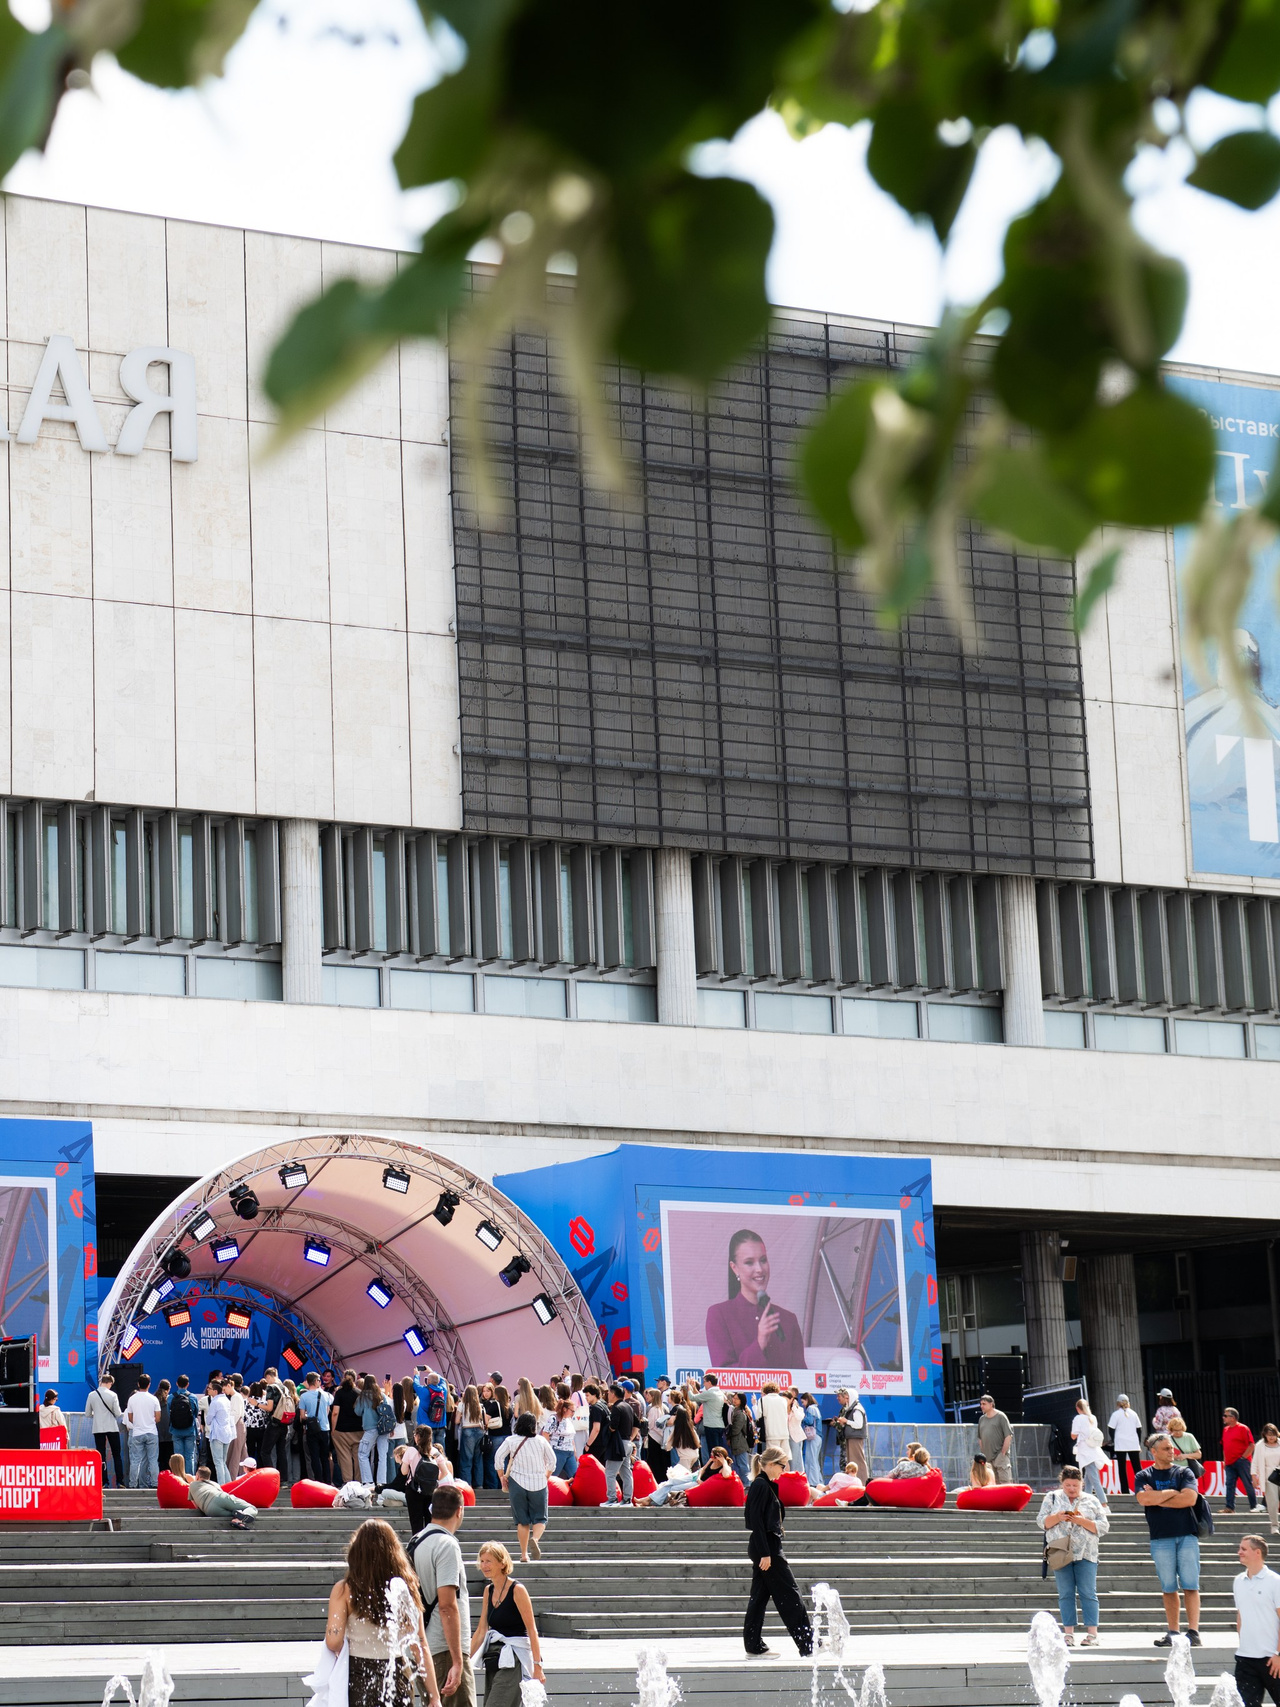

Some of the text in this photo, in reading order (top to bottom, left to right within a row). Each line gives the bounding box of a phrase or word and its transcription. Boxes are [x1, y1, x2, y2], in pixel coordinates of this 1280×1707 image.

[1198, 407, 1280, 438] ыставк
[200, 1327, 250, 1339] МОСКОВСКИЙ
[200, 1338, 225, 1350] СПОРТ
[715, 1372, 789, 1387] ИЗКУЛЬТУРНИКА
